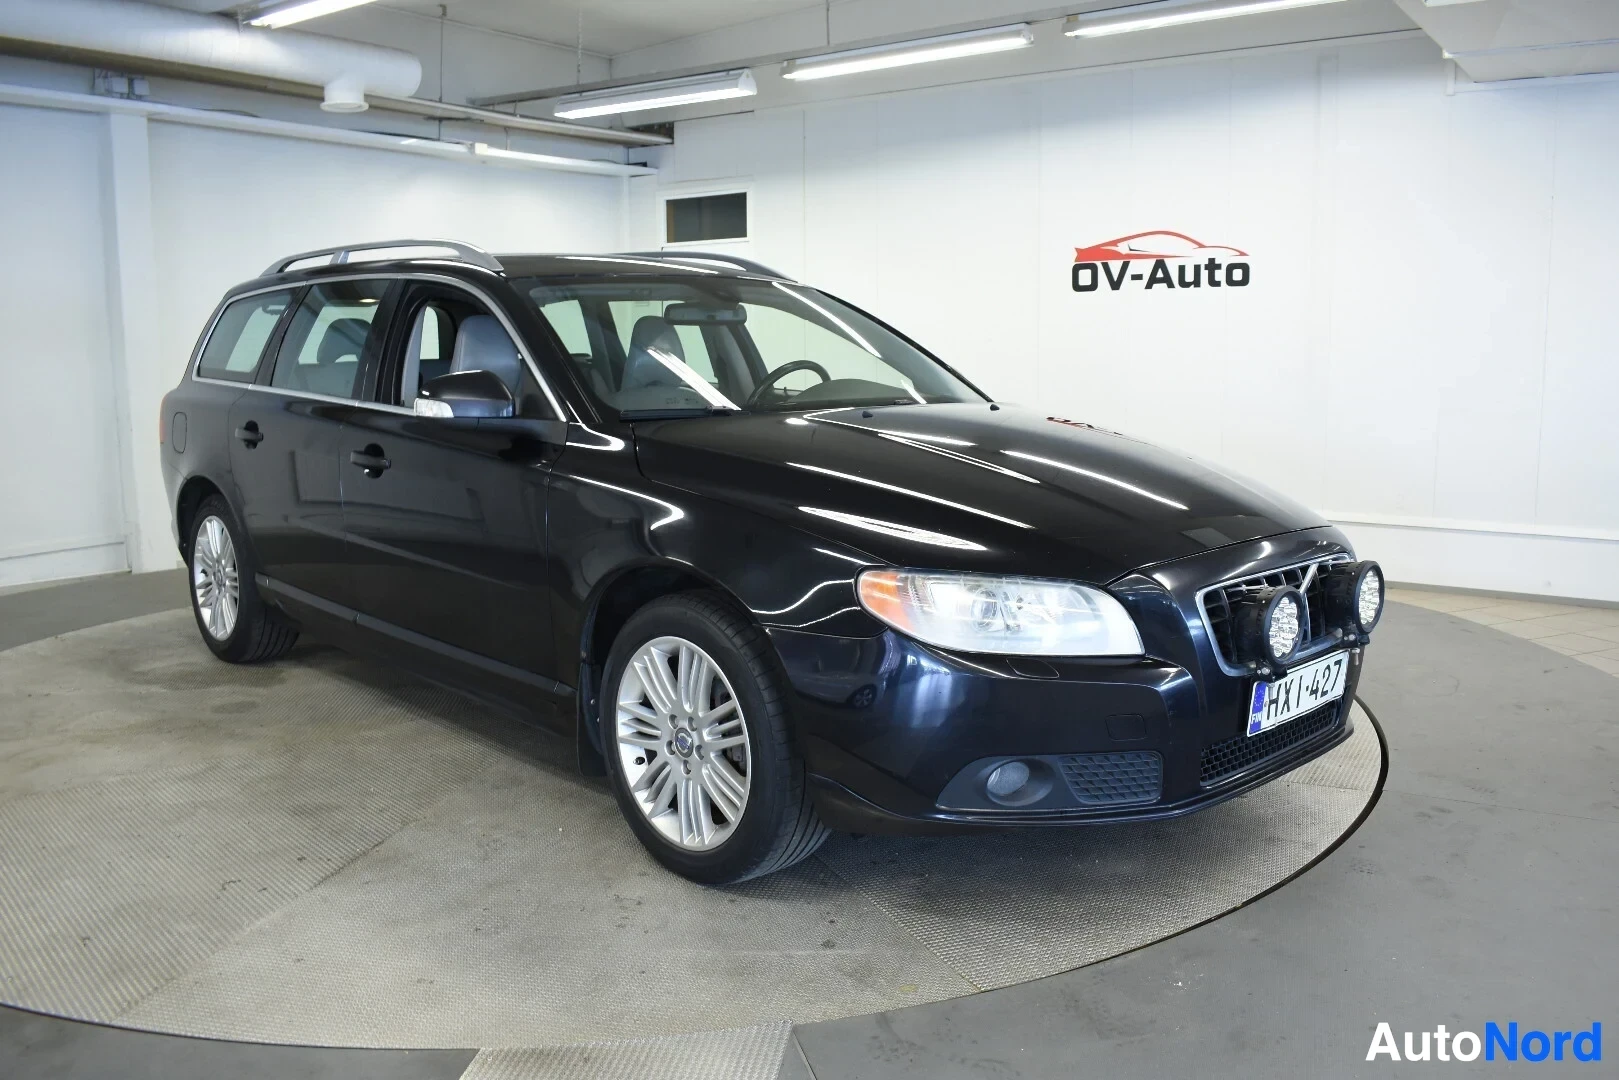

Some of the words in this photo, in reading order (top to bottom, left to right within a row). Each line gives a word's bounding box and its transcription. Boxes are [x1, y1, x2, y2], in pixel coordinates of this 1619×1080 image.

[1072, 257, 1250, 292] OV-Auto
[1267, 658, 1343, 721] HXI-427
[1250, 711, 1263, 725] FIN
